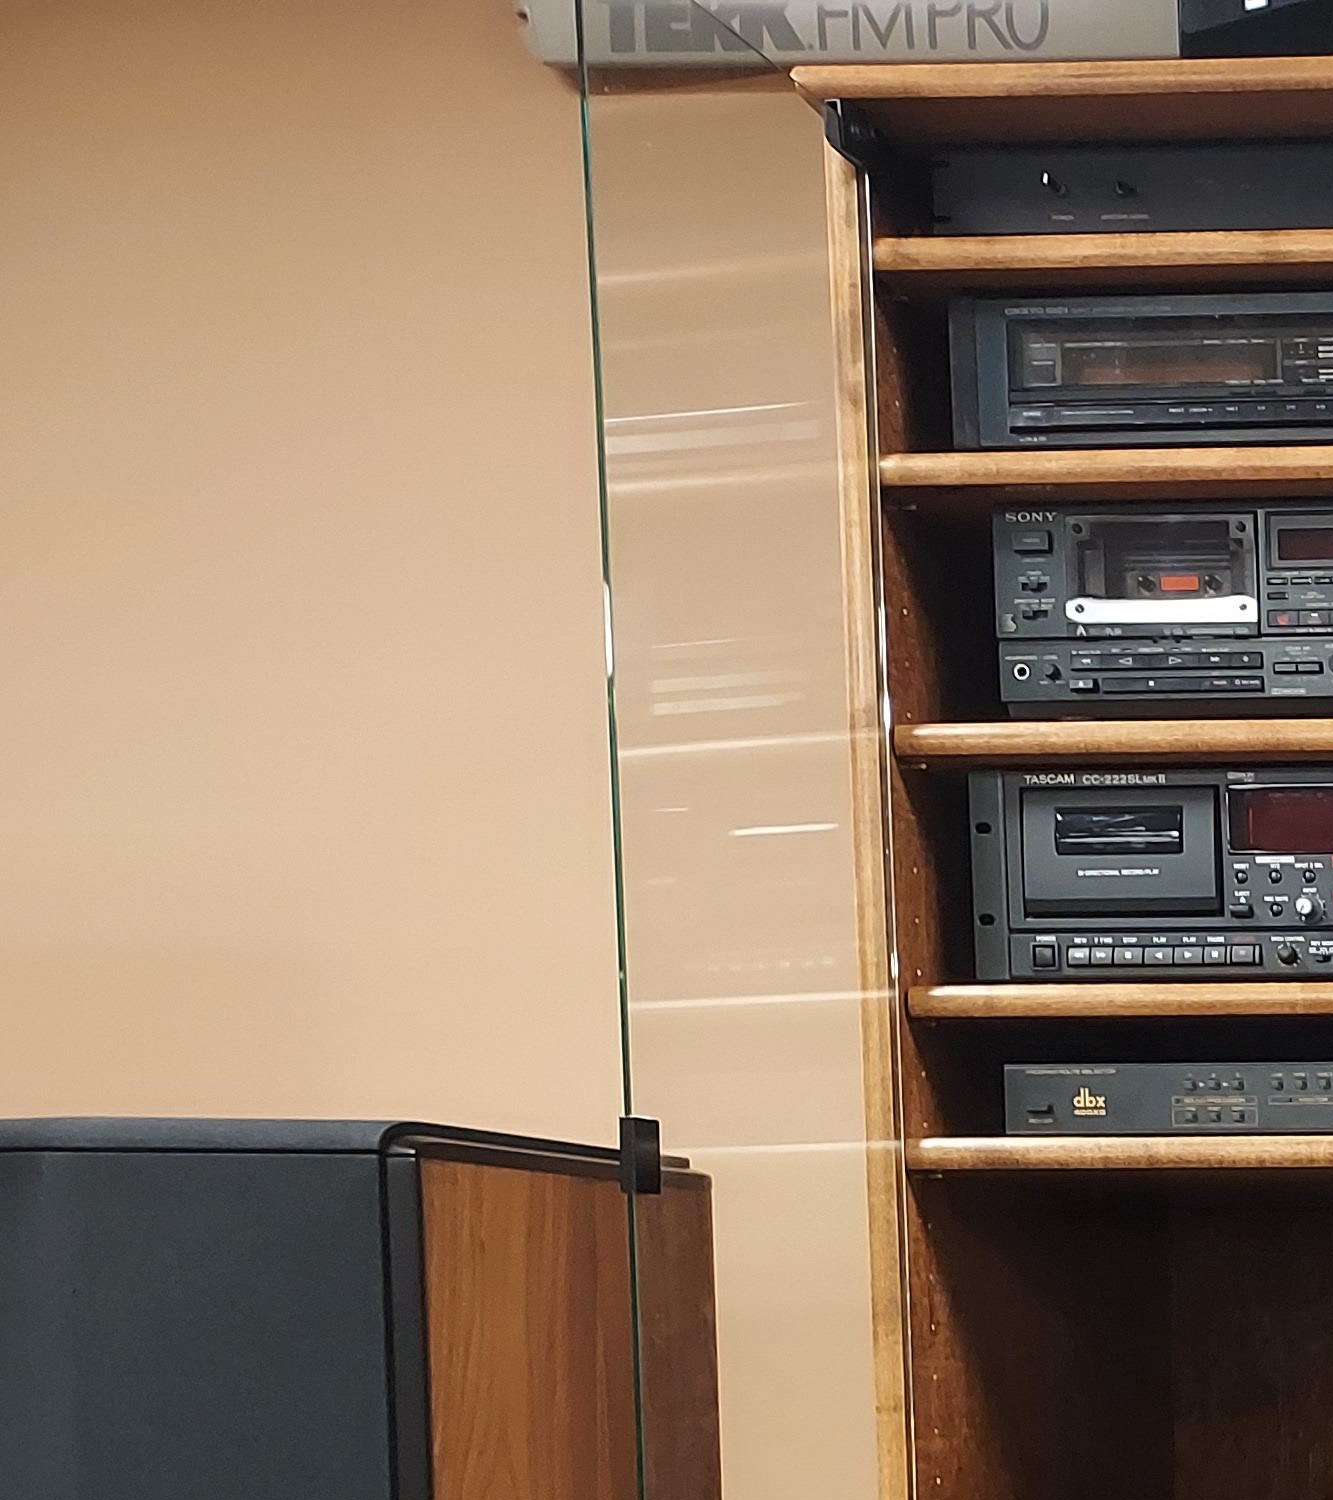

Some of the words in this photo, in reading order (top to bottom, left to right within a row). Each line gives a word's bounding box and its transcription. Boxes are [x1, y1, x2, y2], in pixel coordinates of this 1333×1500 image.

[1005, 511, 1058, 523] SONY
[1024, 774, 1075, 785] TASCAM
[1073, 1087, 1106, 1108] dbx
